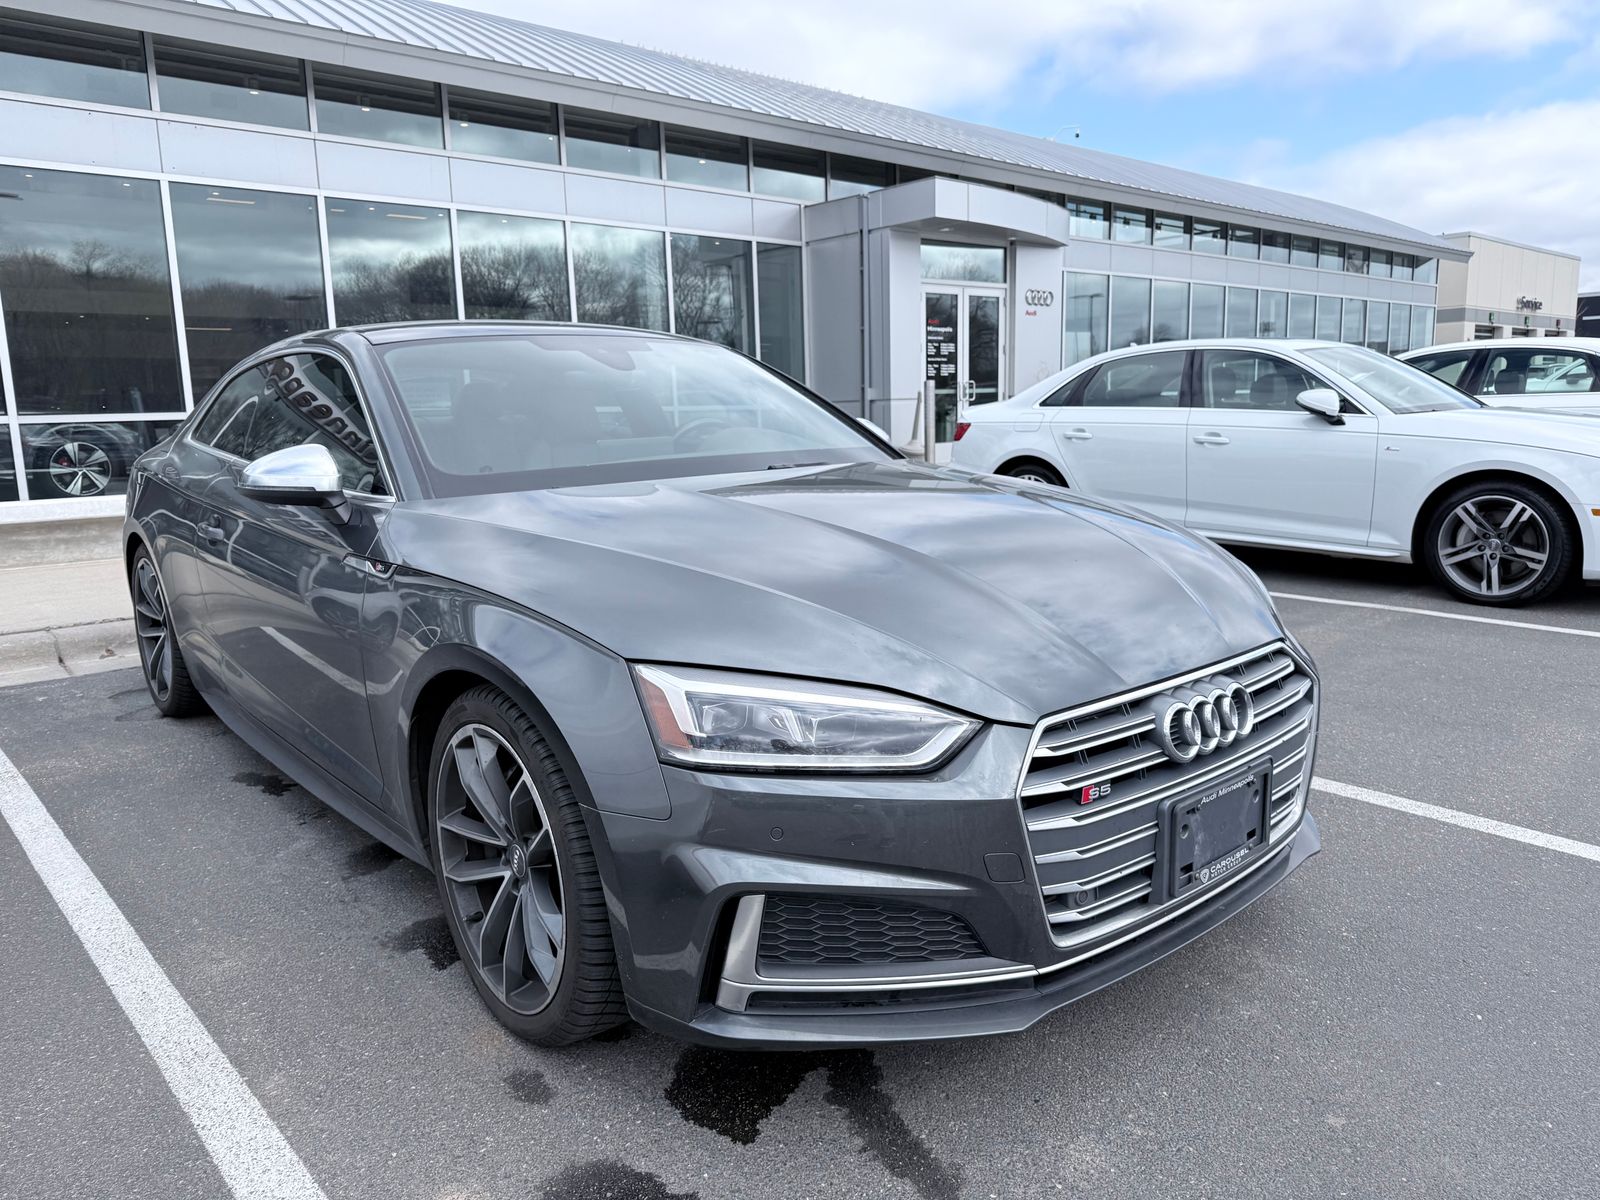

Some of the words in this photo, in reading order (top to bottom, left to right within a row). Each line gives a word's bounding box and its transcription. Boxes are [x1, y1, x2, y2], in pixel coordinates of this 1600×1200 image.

[1087, 784, 1111, 799] S5
[1201, 792, 1217, 804] Audi
[1218, 774, 1254, 797] Minneapolis
[1210, 848, 1249, 873] CAROUSEL
